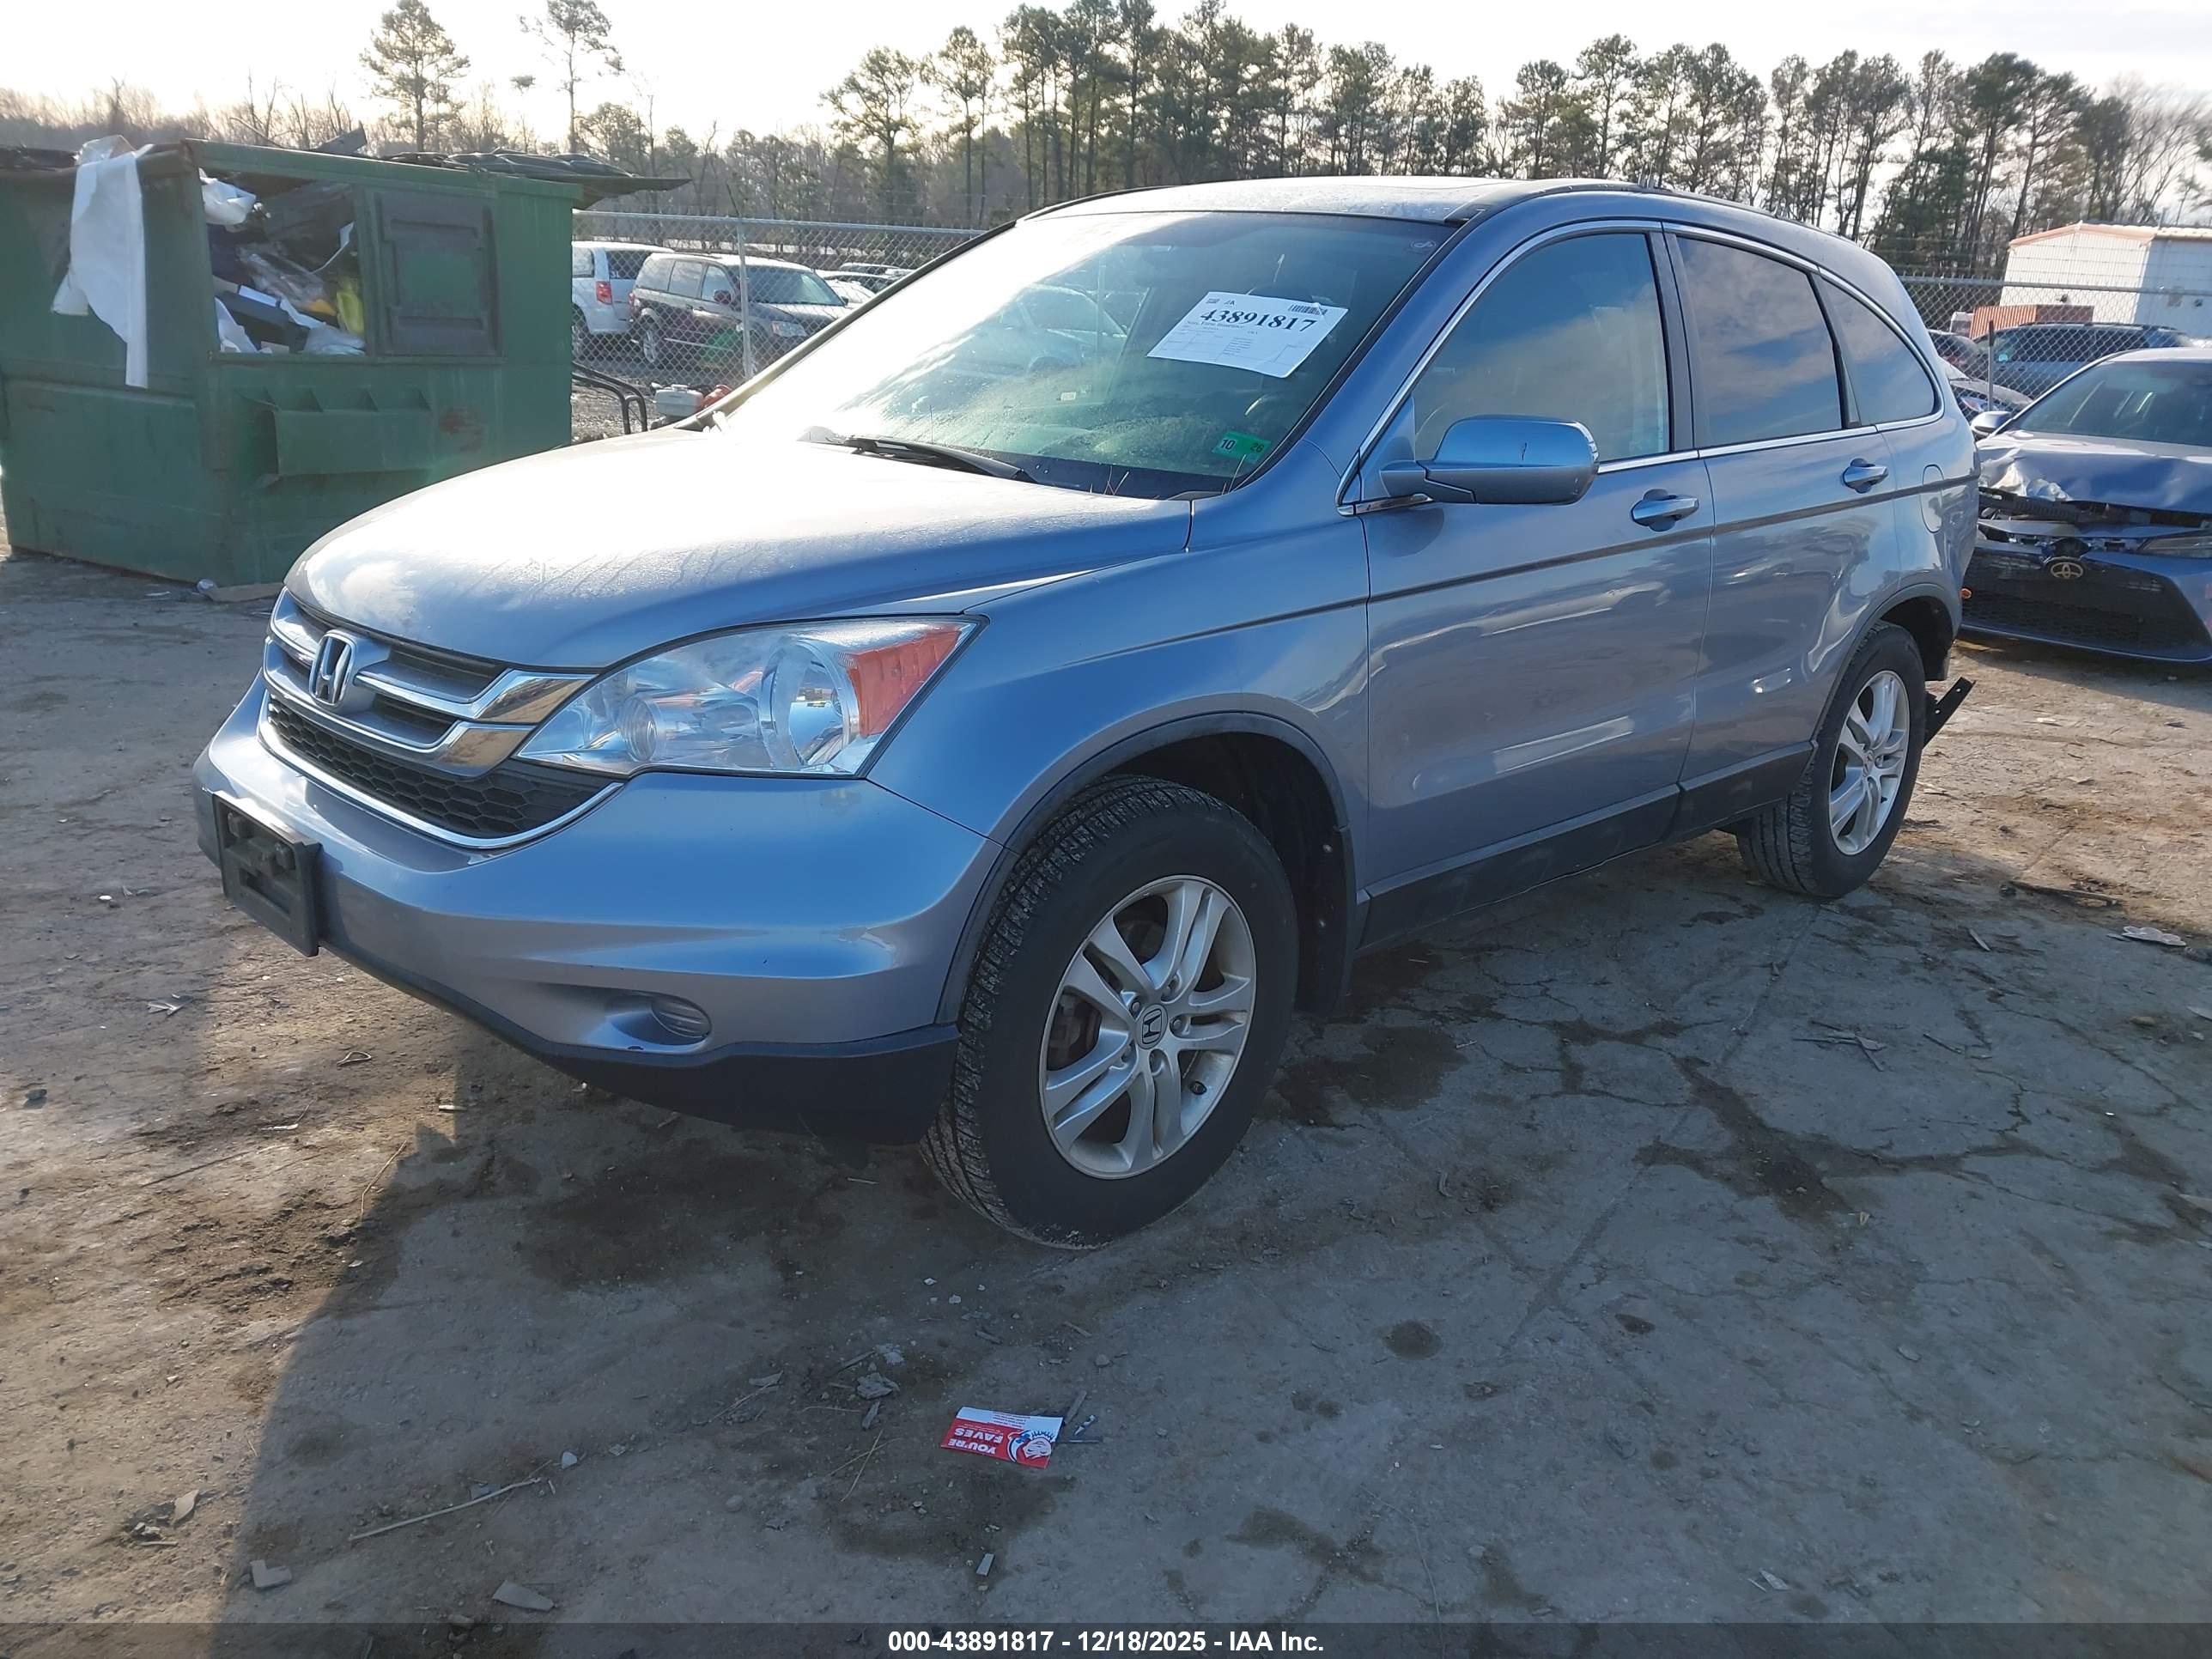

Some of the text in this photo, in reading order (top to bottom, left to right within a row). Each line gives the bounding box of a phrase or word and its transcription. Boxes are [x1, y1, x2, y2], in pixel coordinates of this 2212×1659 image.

[1200, 309, 1318, 331] 43891817
[1221, 439, 1236, 450] 10
[955, 1427, 1004, 1443] FAVES
[948, 1438, 996, 1455] YOU'RE
